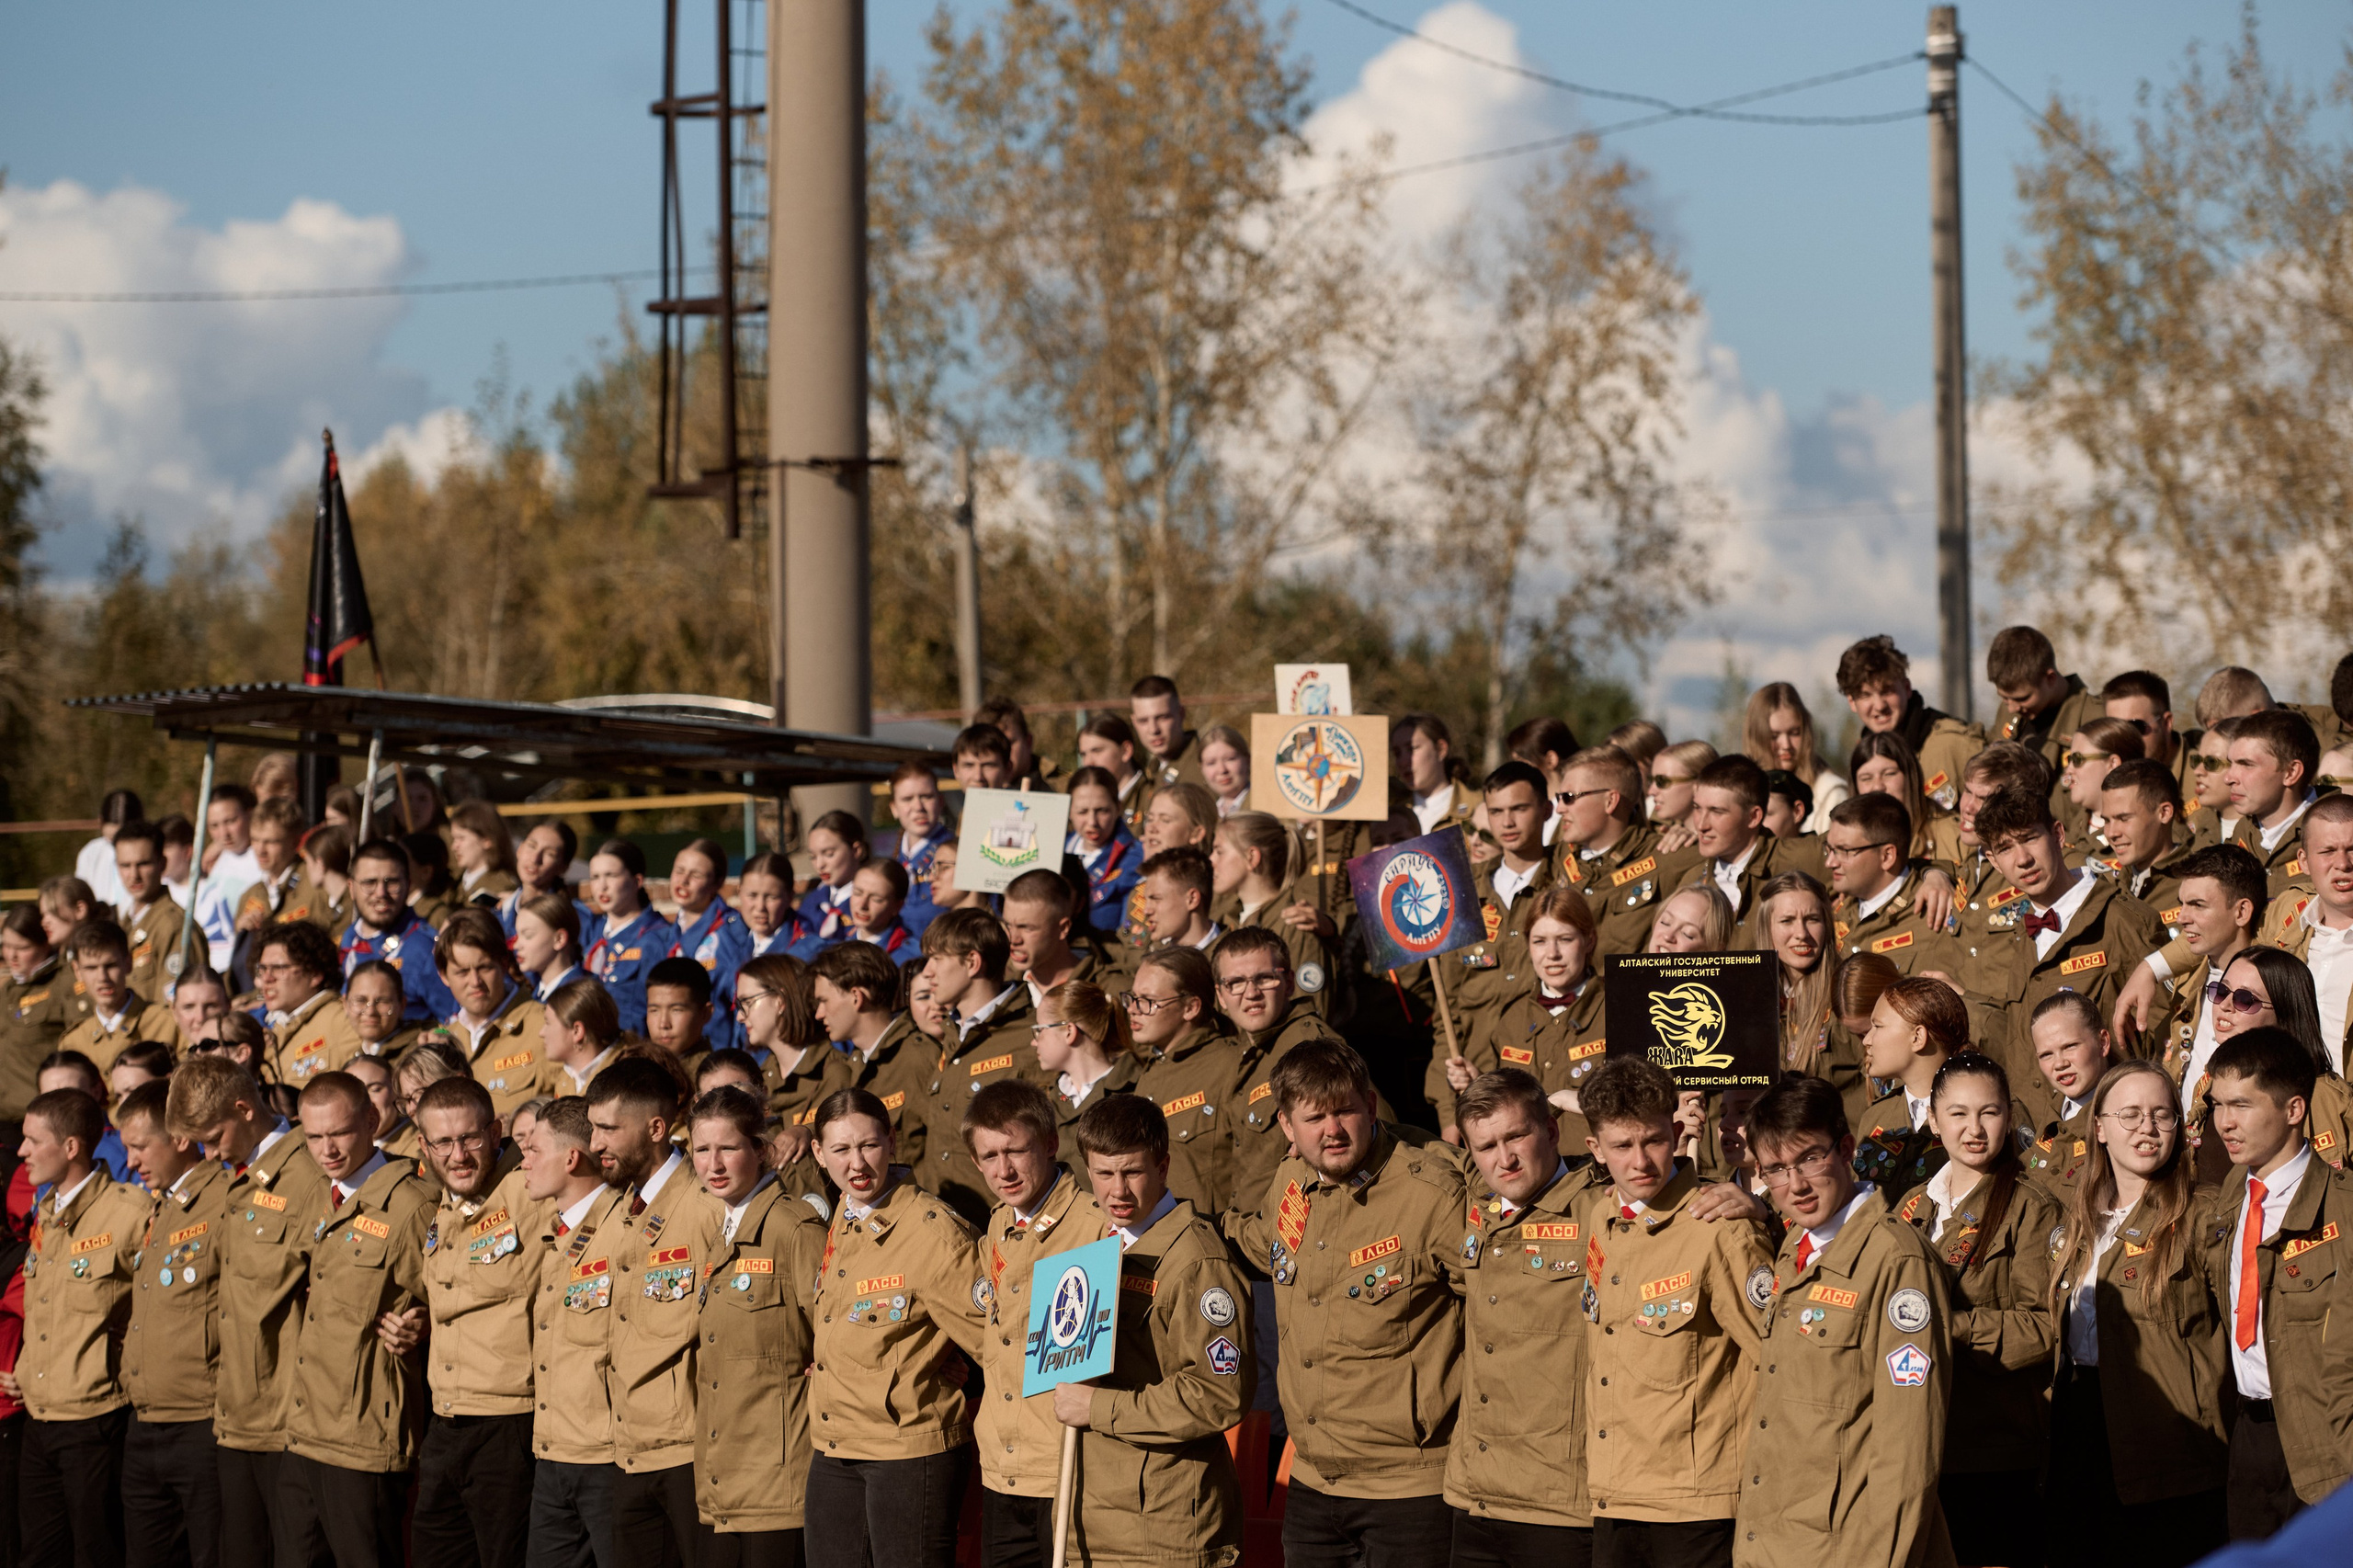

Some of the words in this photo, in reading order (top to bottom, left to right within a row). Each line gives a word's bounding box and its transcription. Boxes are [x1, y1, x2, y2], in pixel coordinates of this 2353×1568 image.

[1619, 957, 1672, 968] АЛТАЙСКИЙ
[1674, 955, 1761, 966] ГОСУДАРСТВЕННЫЙ
[1659, 968, 1721, 978] УНИВЕРСИТЕТ
[1684, 1075, 1738, 1085] СЕРВИСНЫЙ
[1740, 1076, 1769, 1085] ОТРЯД
[1540, 1224, 1574, 1237] ЛСО
[1366, 1240, 1395, 1259] ЛСО
[870, 1278, 899, 1290] ЛСО
[1658, 1274, 1688, 1294] ЛСО
[1823, 1289, 1853, 1304] ЛСО
[1043, 1344, 1086, 1373] РИТМ
